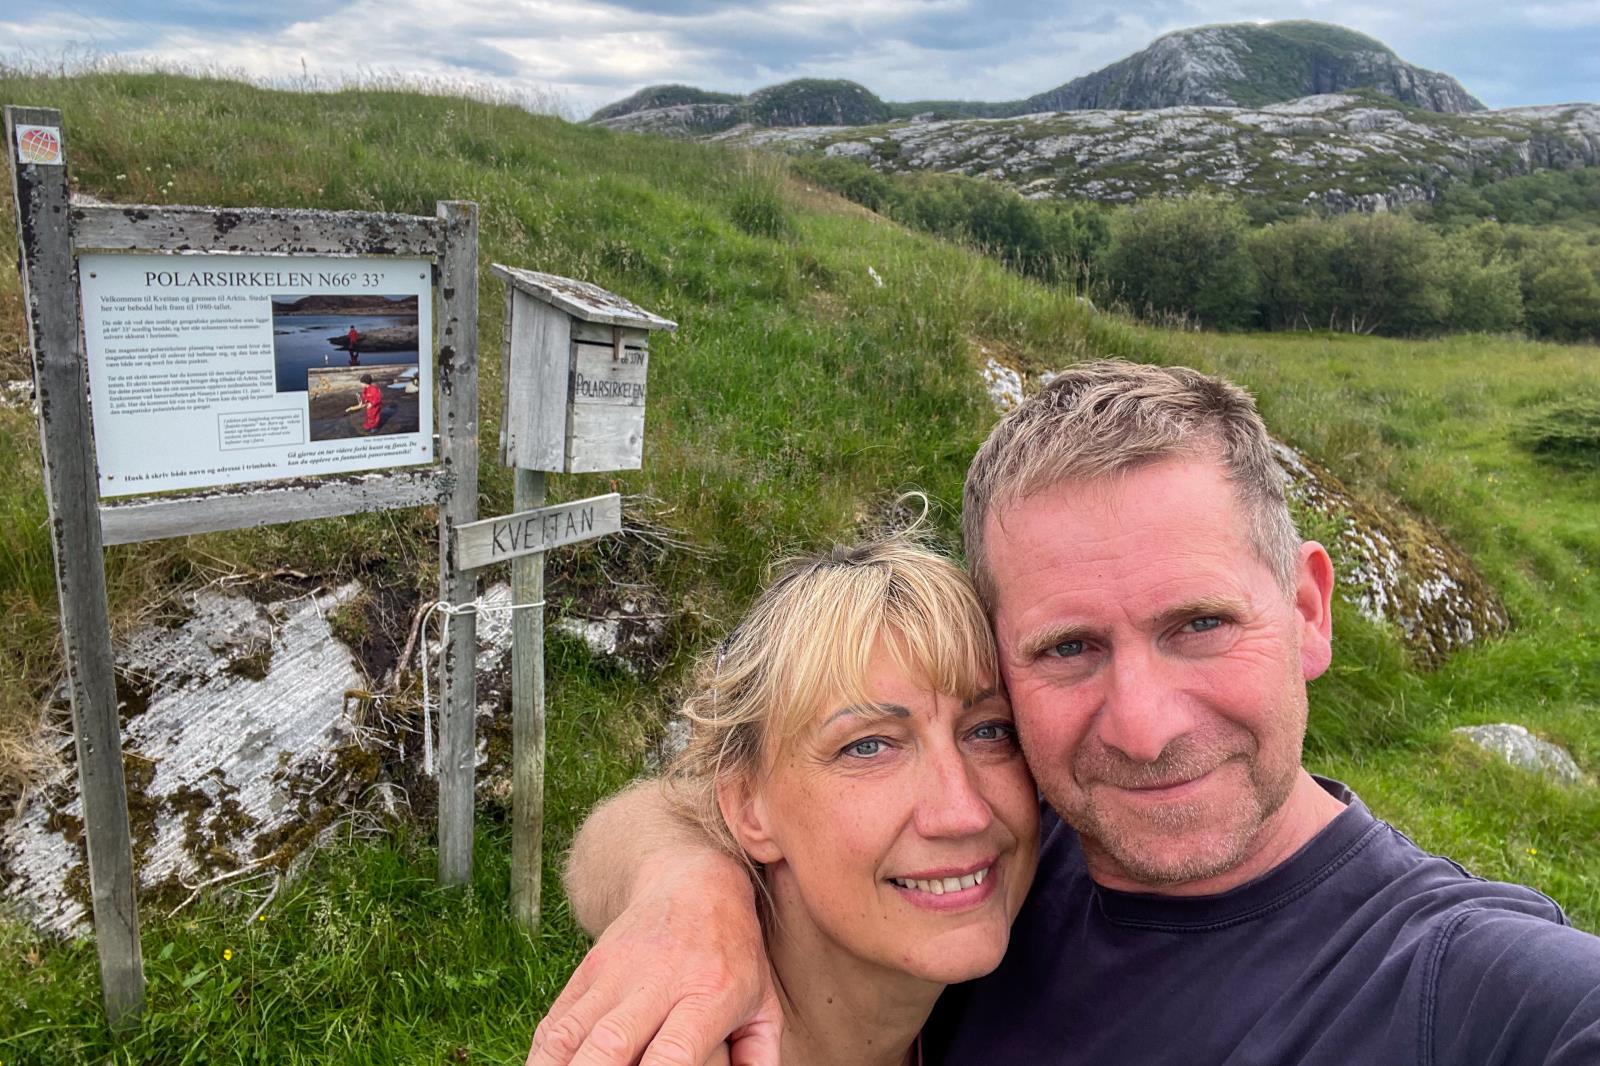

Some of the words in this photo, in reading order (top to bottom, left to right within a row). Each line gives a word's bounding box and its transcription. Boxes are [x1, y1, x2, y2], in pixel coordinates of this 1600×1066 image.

[144, 271, 312, 287] POLARSIRKELEN
[318, 272, 357, 287] N66°
[101, 304, 112, 312] her
[576, 373, 645, 398] POLARSIRKELEN
[287, 458, 299, 466] kan
[299, 457, 308, 465] du
[308, 455, 331, 466] oppleve
[339, 452, 367, 464] fantastisk
[297, 449, 316, 460] gjerne
[335, 446, 353, 454] videre
[353, 445, 367, 454] forbi
[368, 443, 383, 451] huset
[124, 474, 143, 482] Husk
[216, 465, 240, 473] adresse
[492, 507, 594, 557] KVEITAN
